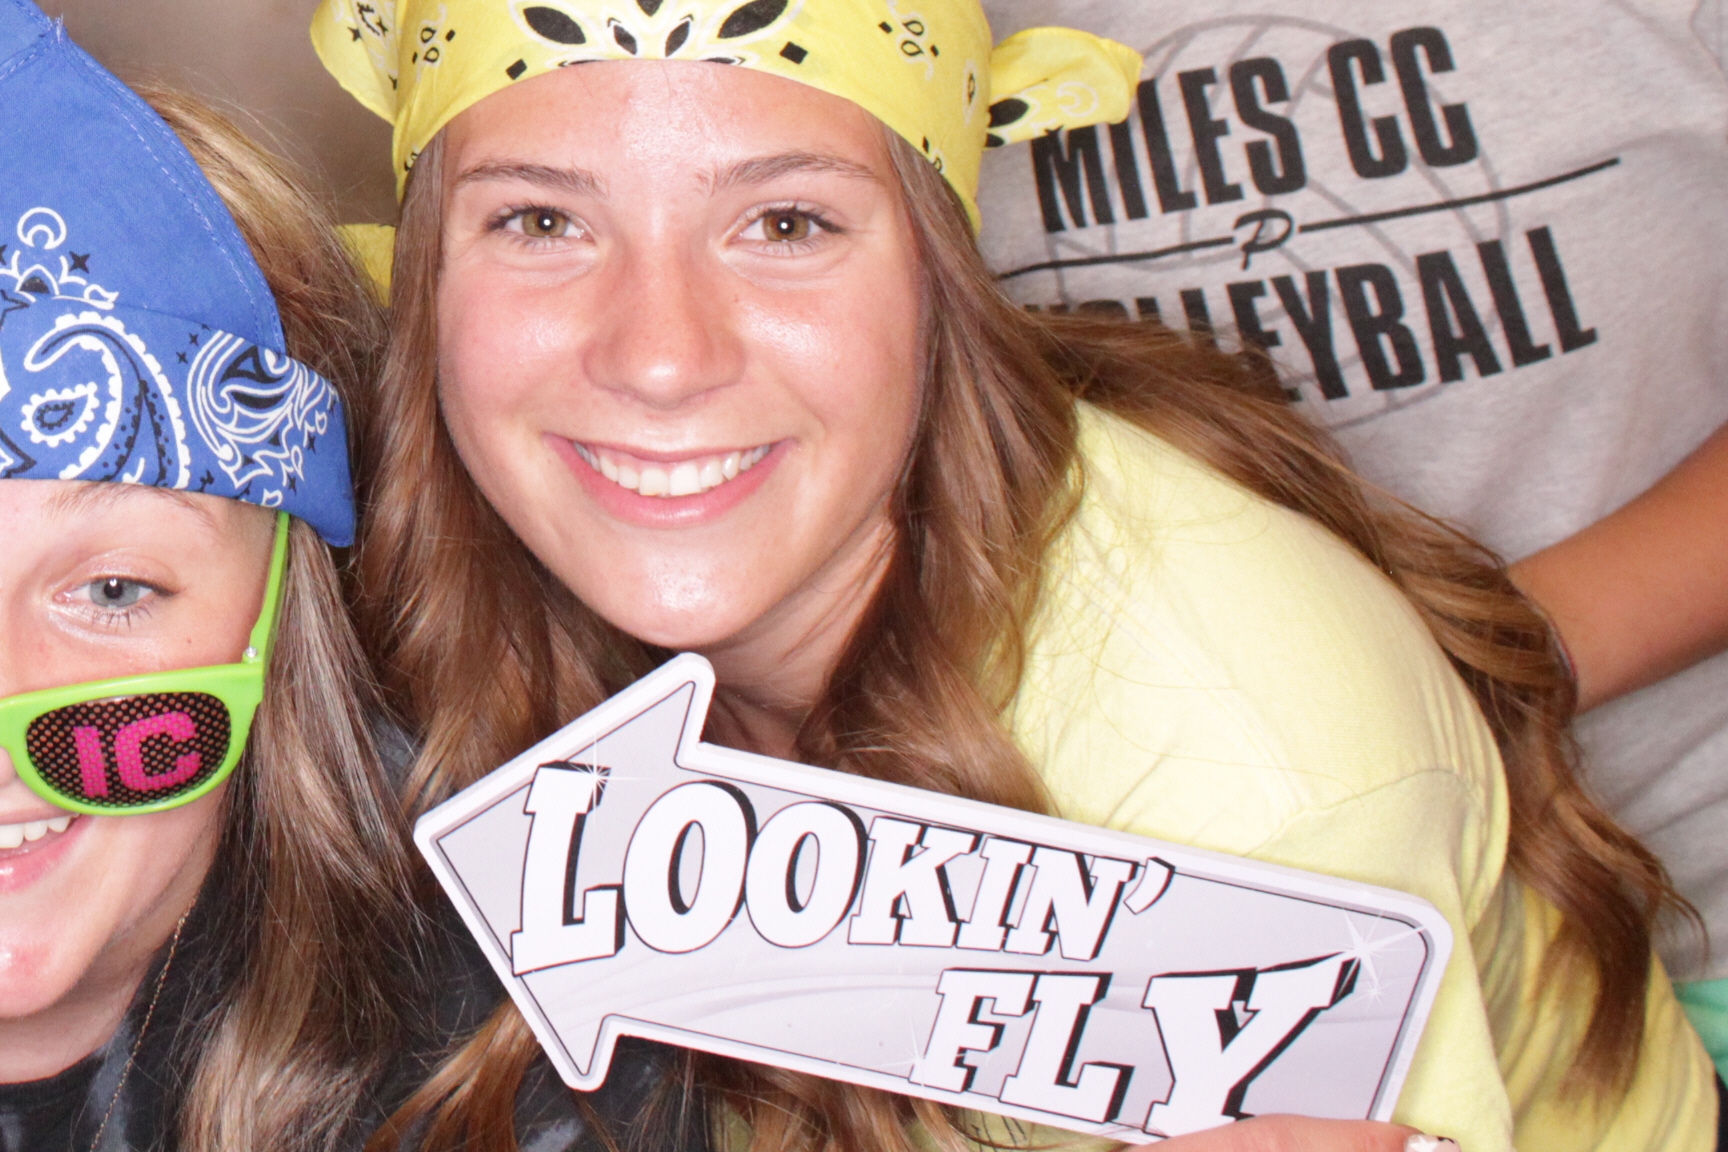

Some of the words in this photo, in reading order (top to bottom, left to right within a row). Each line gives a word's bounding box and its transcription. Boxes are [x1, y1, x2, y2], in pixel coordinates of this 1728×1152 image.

[1030, 56, 1307, 233] MILES
[1327, 25, 1480, 180] CC
[1023, 225, 1598, 401] EYBALL
[71, 711, 202, 798] IC
[510, 760, 1175, 976] LOOKIN'
[908, 949, 1361, 1139] FLY
